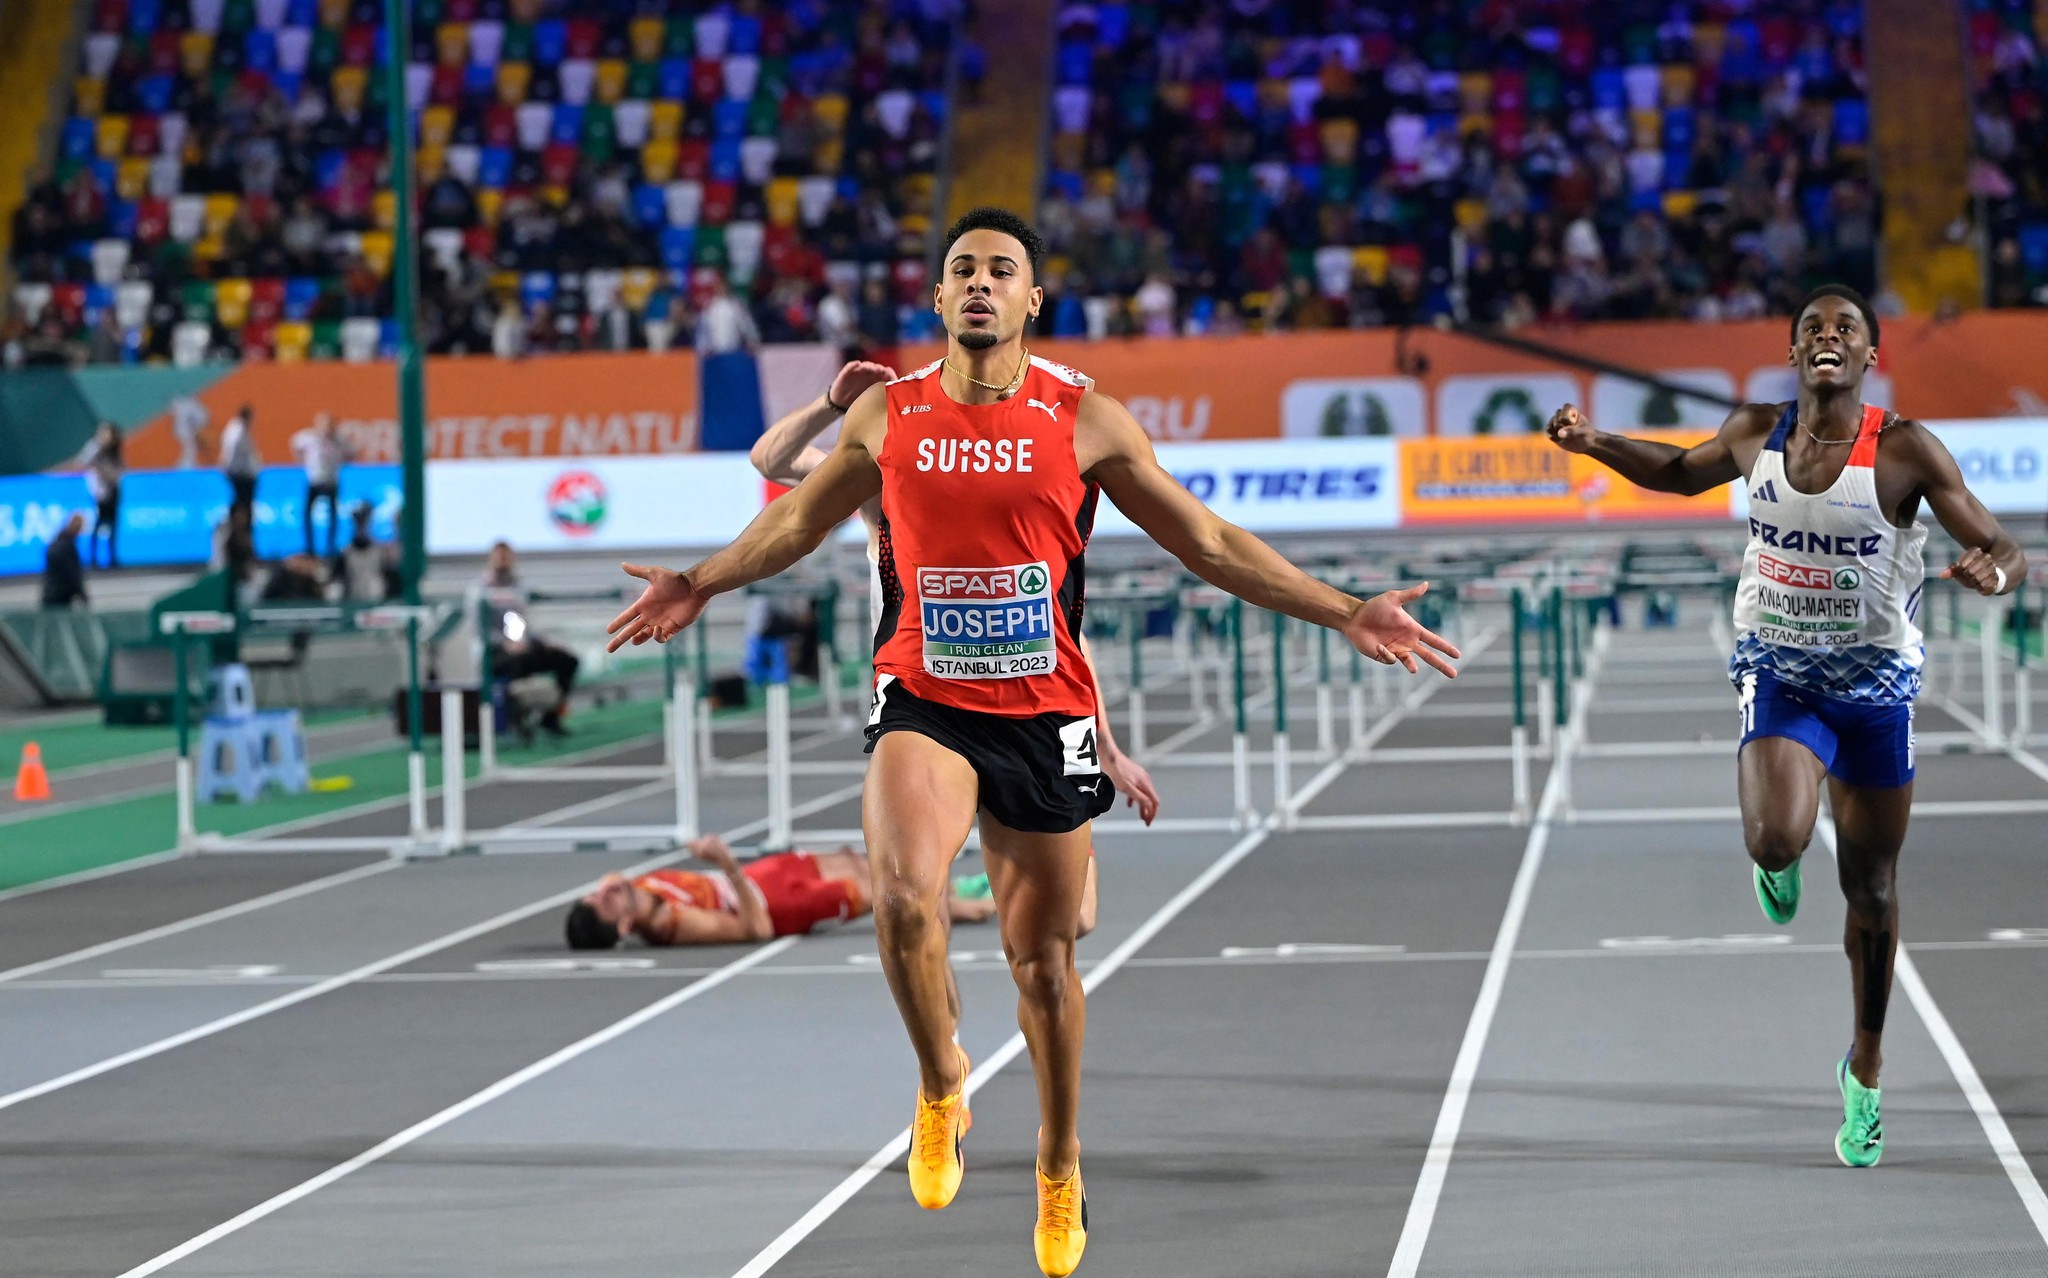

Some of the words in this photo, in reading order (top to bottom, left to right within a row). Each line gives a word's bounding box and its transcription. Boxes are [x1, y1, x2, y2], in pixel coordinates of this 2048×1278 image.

[912, 404, 932, 413] UBS
[338, 413, 554, 463] PRTECT
[1230, 466, 1381, 499] TIRES
[1748, 516, 1882, 556] FRANCE
[922, 573, 1013, 595] SPAR
[1760, 556, 1830, 587] SPAR
[1758, 583, 1860, 618] KWAOU-MATHEY
[925, 603, 1048, 638] JOSEPH
[1758, 626, 1823, 646] ISTANBUL
[1825, 632, 1859, 646] 2023
[1781, 619, 1801, 630] RUN
[1803, 622, 1838, 631] CLEAN
[932, 659, 1008, 675] ISTANBUL
[1009, 656, 1049, 672] 2023
[955, 646, 981, 656] RUN
[1076, 727, 1098, 767] 4
